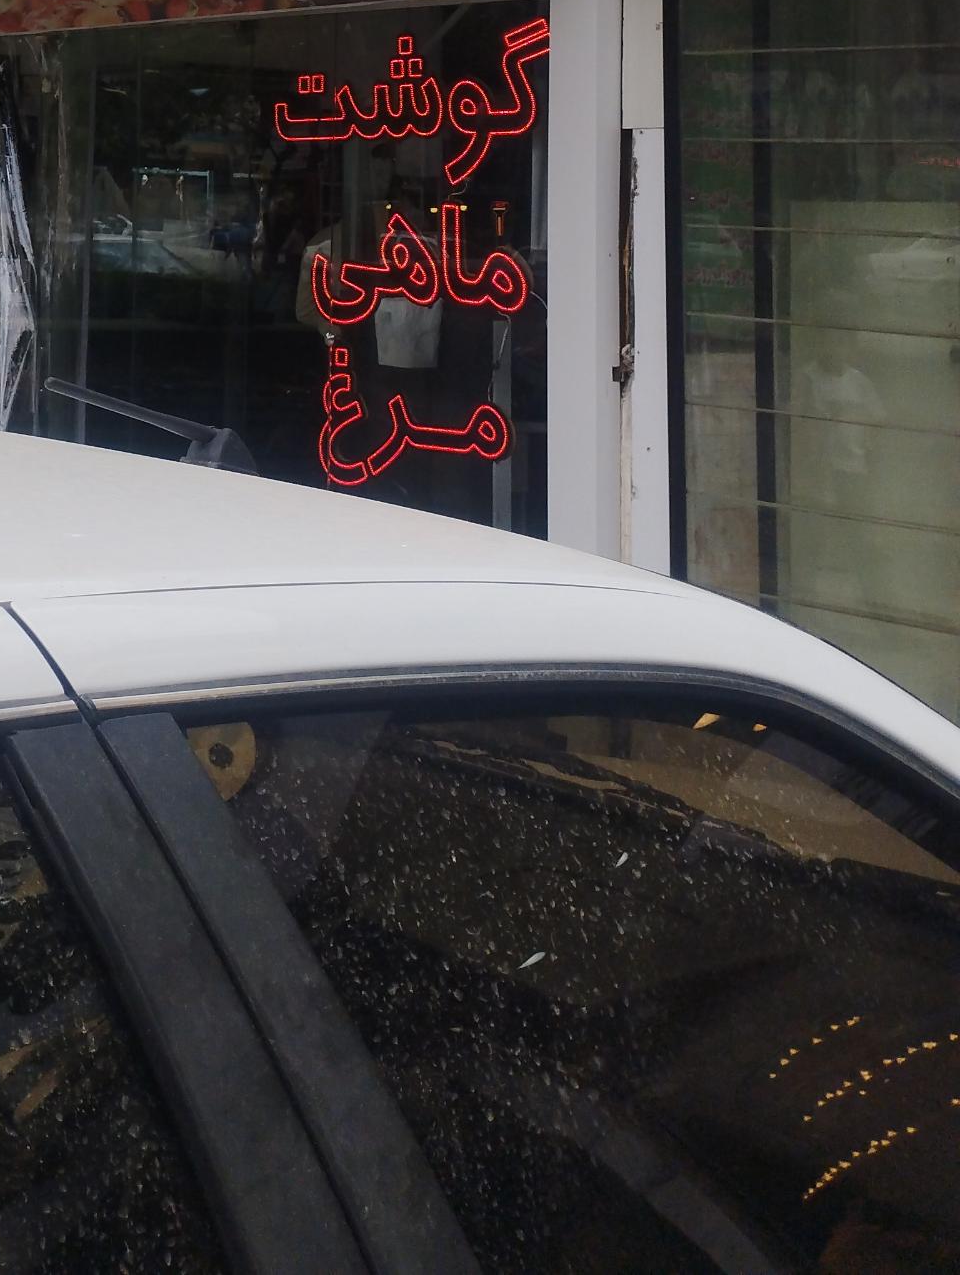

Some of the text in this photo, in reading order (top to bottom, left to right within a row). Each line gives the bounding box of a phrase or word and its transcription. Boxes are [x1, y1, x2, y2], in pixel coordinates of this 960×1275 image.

[274, 18, 551, 185] گوشت
[311, 203, 527, 324] ماهی
[318, 346, 510, 486] مرغ
